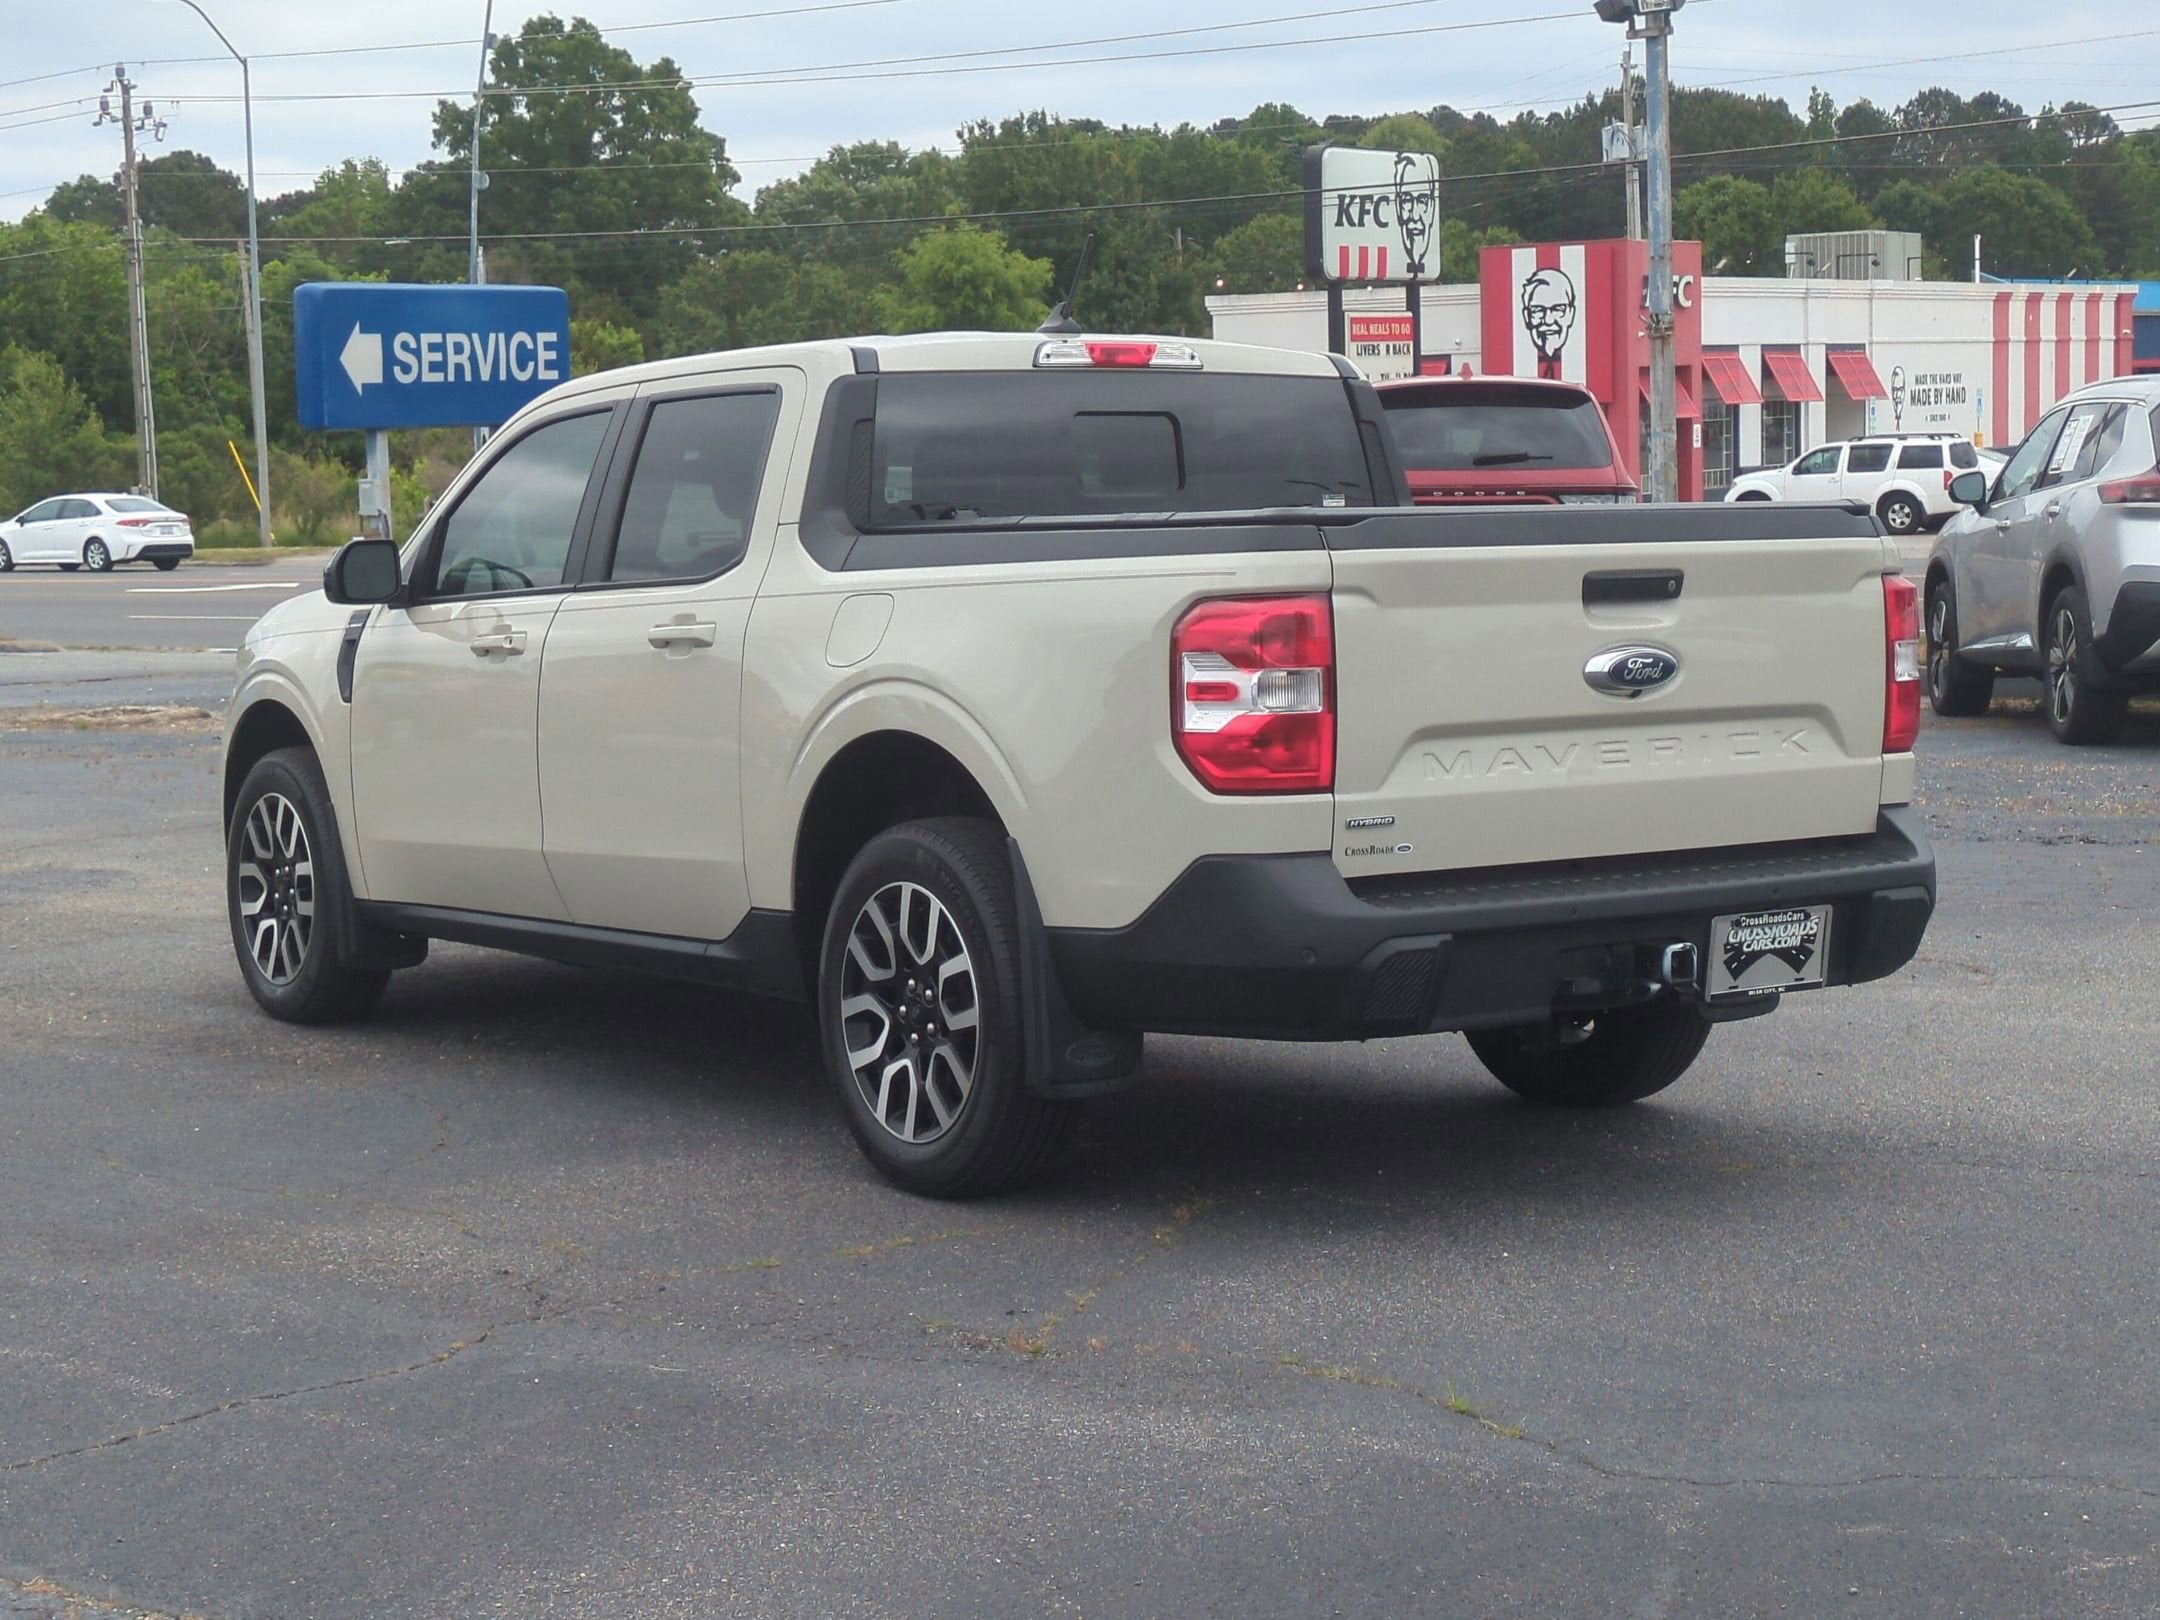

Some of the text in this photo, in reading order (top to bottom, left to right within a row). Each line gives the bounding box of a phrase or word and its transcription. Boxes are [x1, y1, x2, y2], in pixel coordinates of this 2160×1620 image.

[1334, 194, 1391, 228] KFC
[1391, 323, 1400, 335] TO
[1401, 323, 1411, 335] GO
[393, 331, 559, 384] SERVICE
[1356, 343, 1411, 356] LIVERS R BACK
[1910, 388, 1932, 407] MADE
[1933, 387, 1943, 405] BY
[1945, 386, 1967, 405] HAND
[1624, 657, 1664, 681] Ford
[1422, 729, 1811, 781] MAVERICK
[1350, 817, 1393, 828] HYBRID
[1740, 911, 1804, 927] CrossRoadsCars
[1743, 935, 1802, 952] CARS.COM
